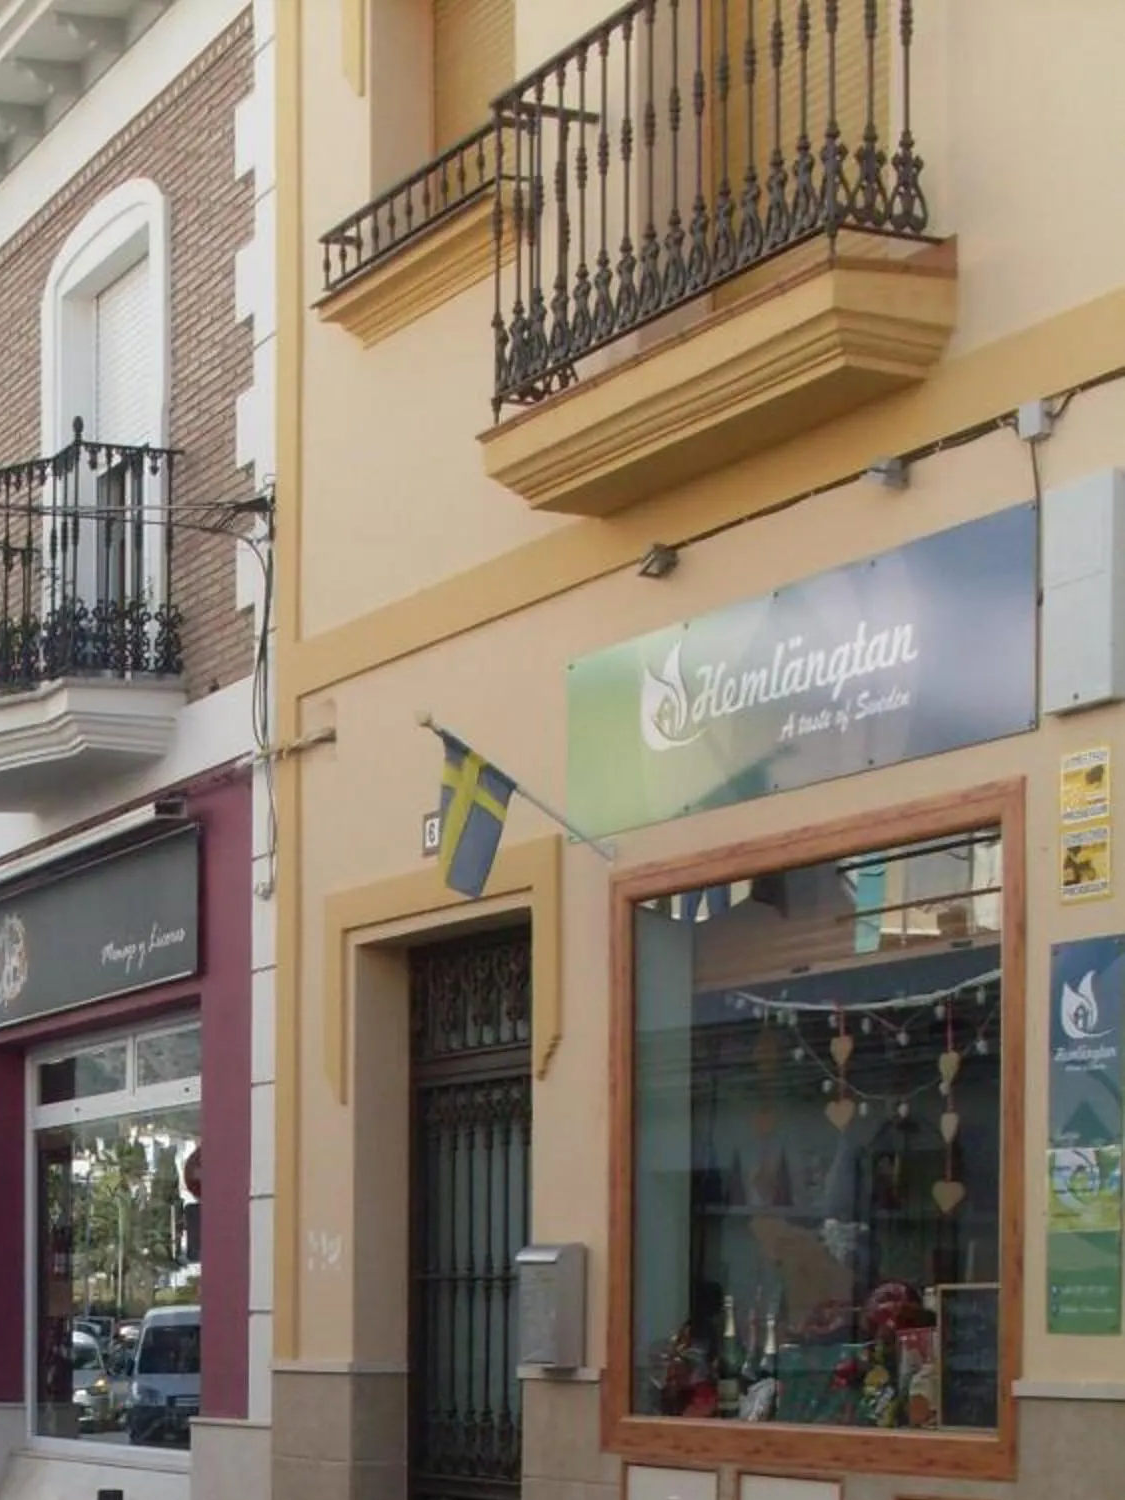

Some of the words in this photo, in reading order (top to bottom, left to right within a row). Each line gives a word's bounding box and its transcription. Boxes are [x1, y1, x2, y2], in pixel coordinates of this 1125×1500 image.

[691, 620, 918, 724] Hemlängtan
[777, 712, 794, 742] A
[855, 684, 911, 721] Sweden
